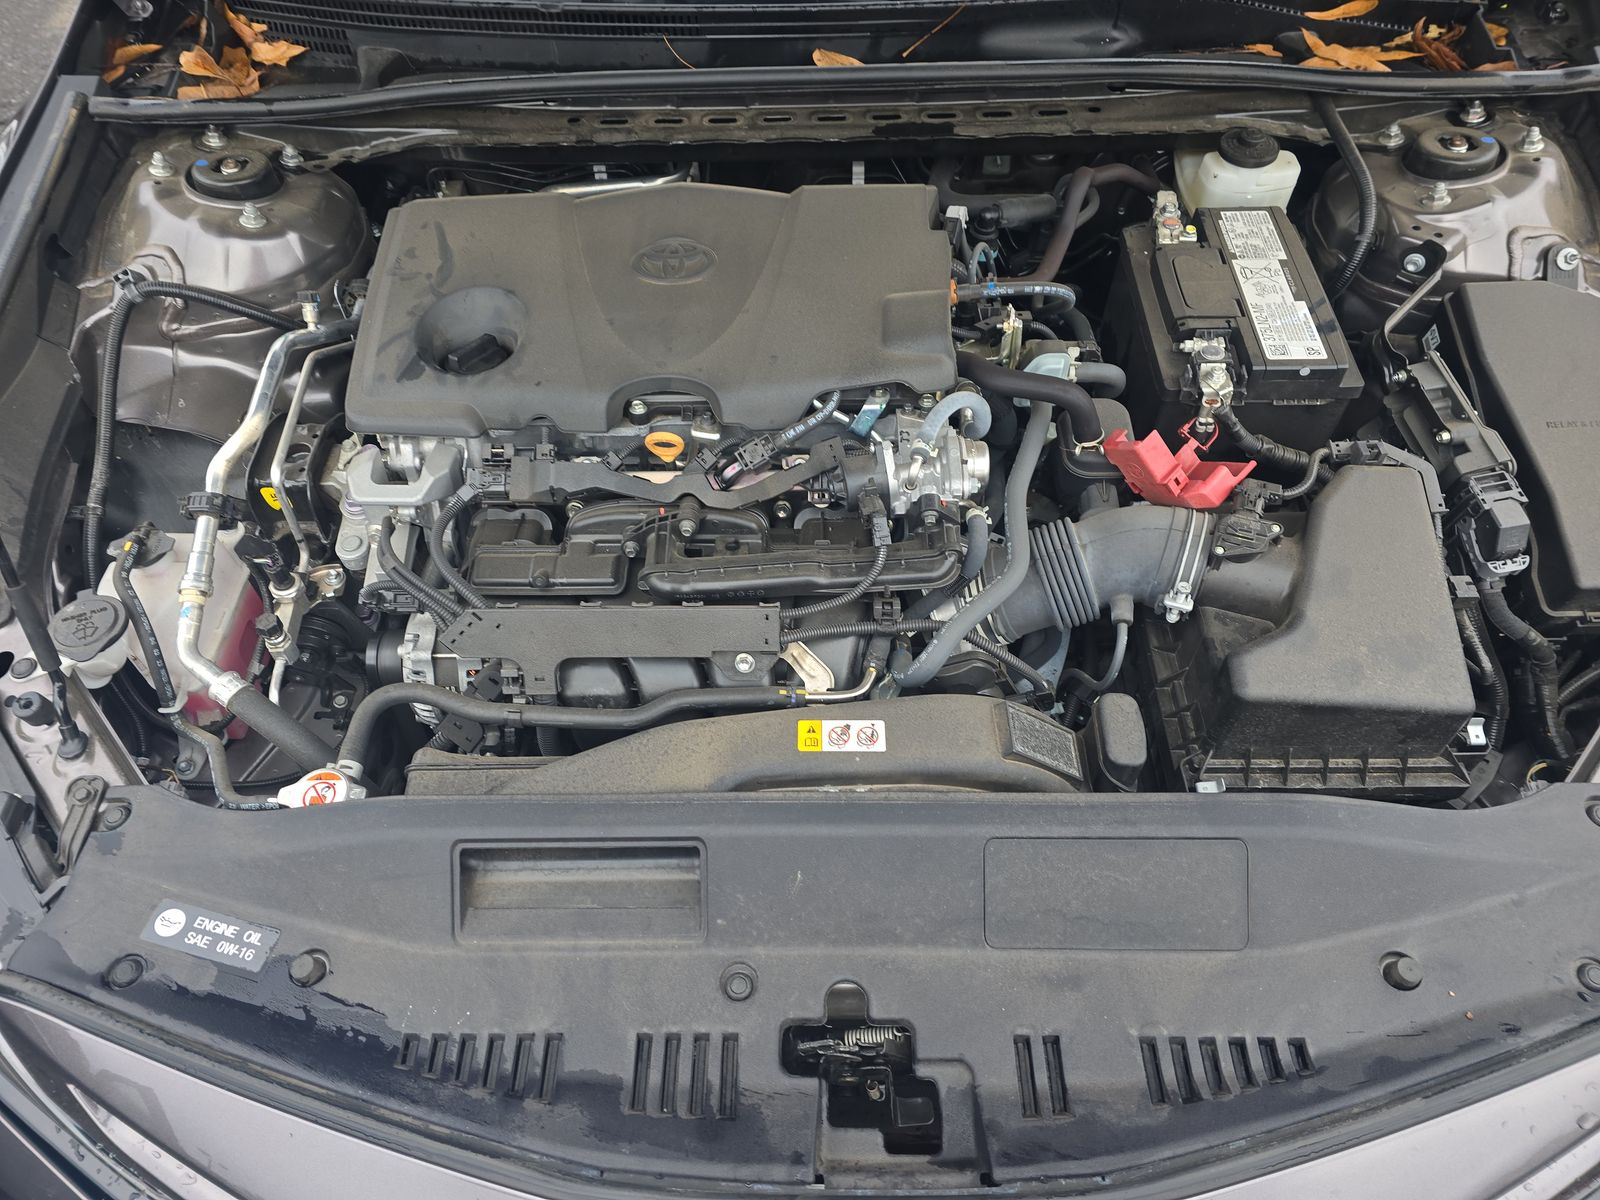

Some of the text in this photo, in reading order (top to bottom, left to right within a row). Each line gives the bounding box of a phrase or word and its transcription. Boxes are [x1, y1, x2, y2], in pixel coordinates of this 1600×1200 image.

[1305, 347, 1321, 355] SP
[193, 915, 262, 946] ENGINE OIL
[184, 931, 256, 961] SAE 0W-16
